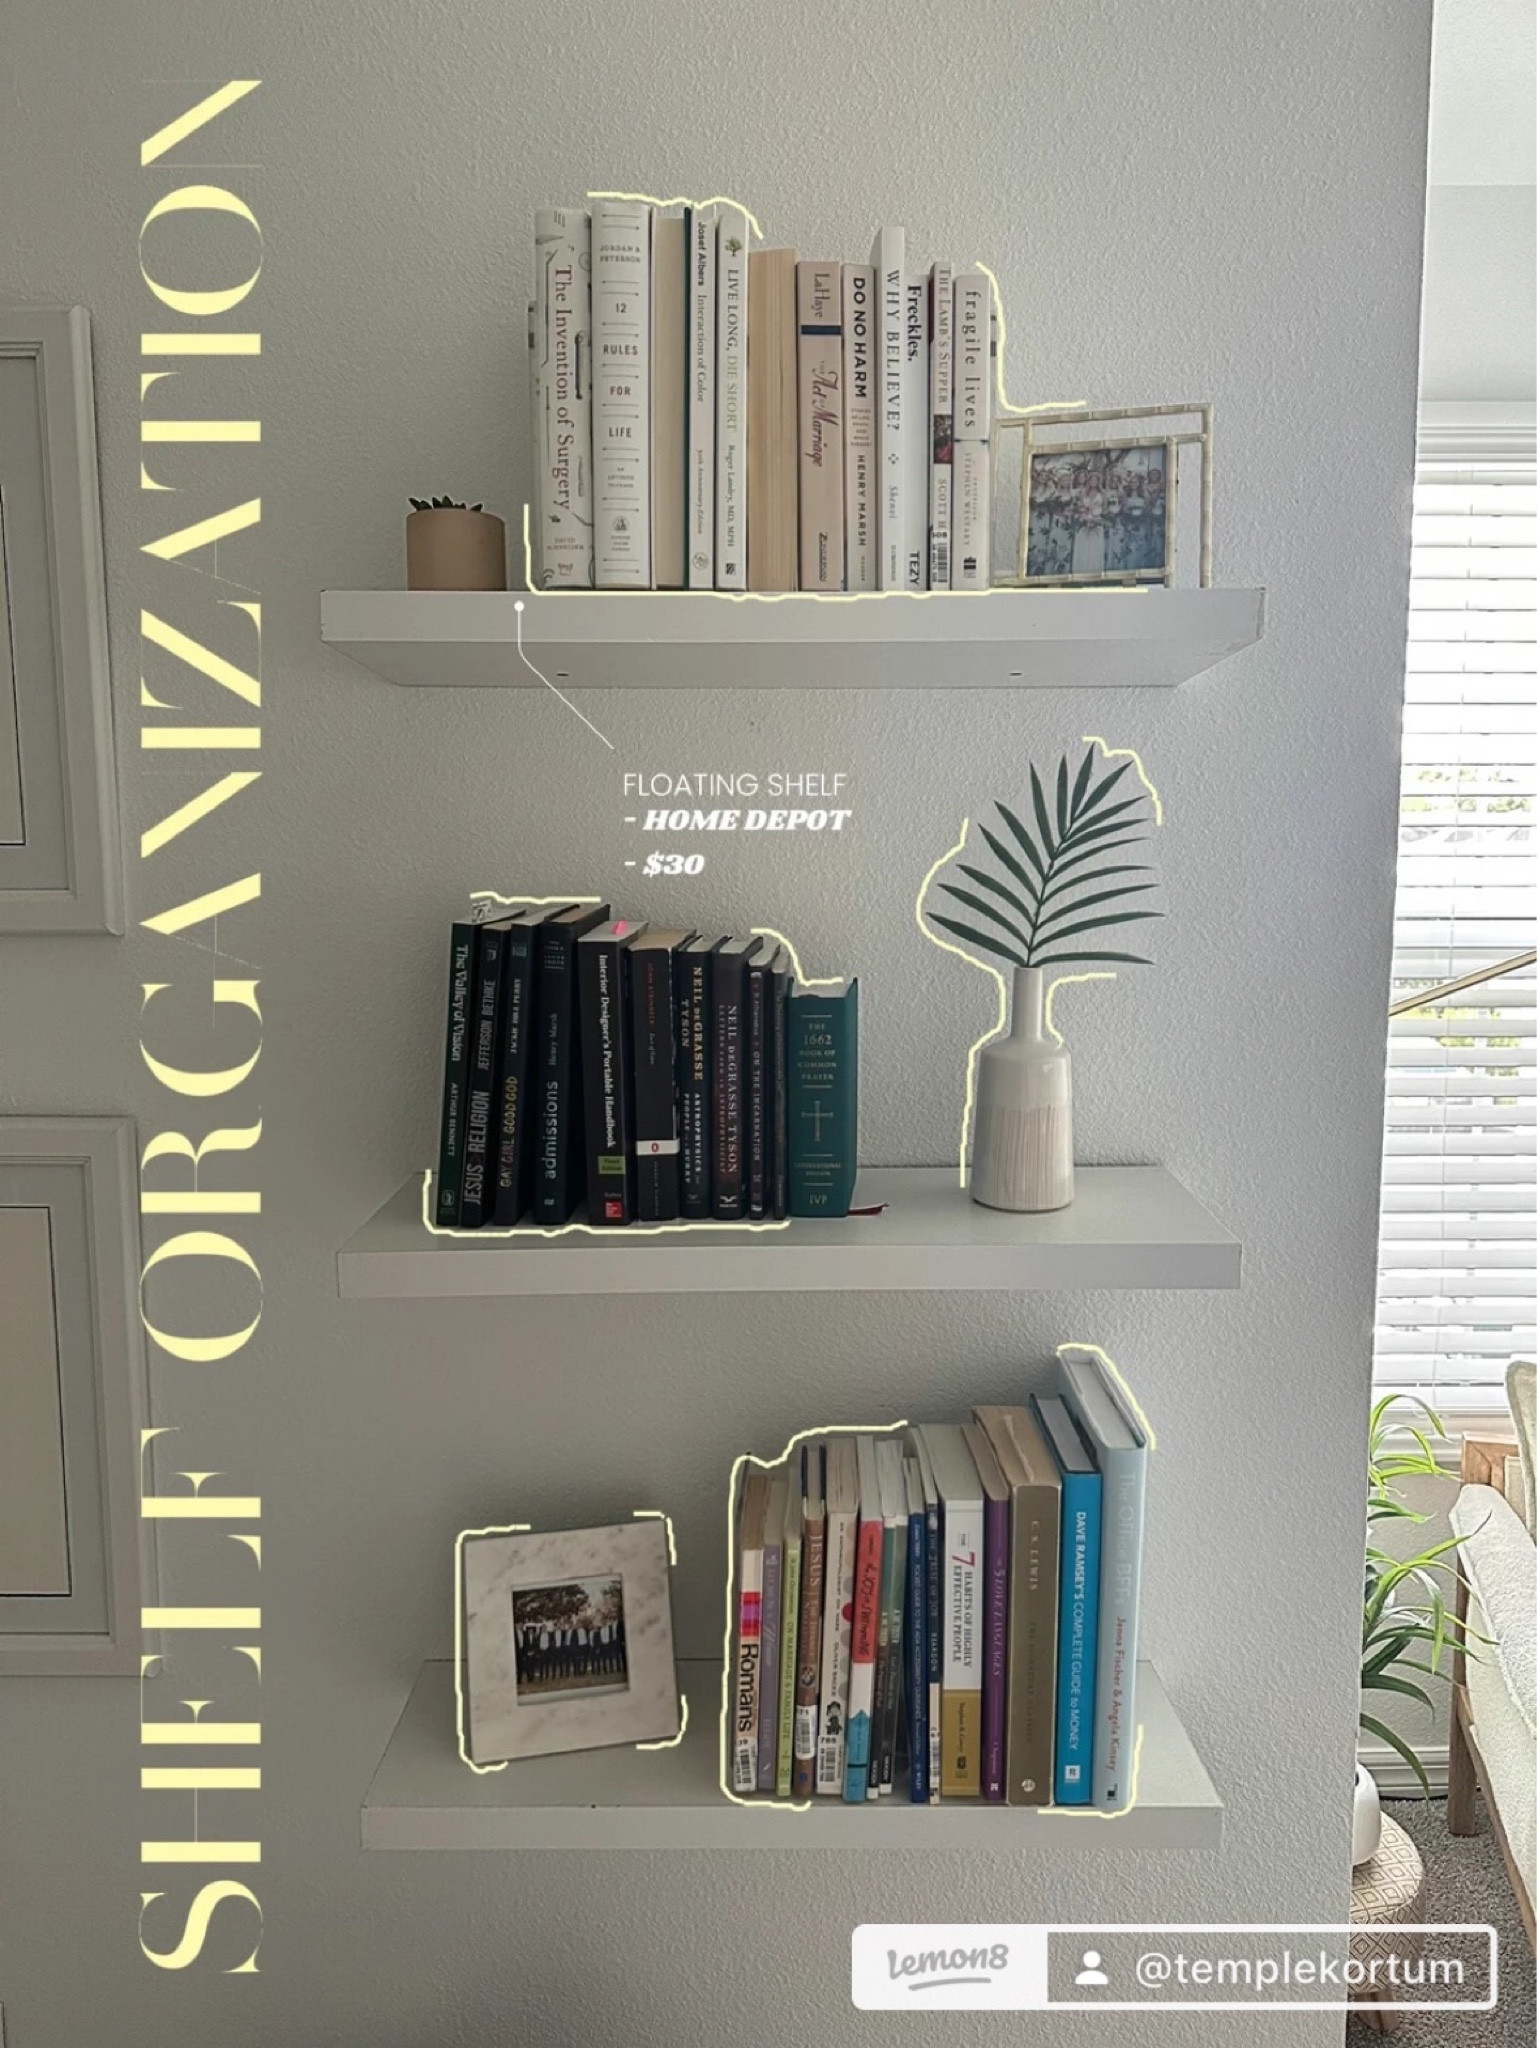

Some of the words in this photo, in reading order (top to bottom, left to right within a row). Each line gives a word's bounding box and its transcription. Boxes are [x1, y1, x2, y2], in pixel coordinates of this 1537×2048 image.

[697, 221, 707, 251] Josef
[555, 264, 573, 302] The
[697, 252, 707, 287] Albers
[726, 268, 739, 301] LIVE
[938, 268, 951, 294] THE
[615, 303, 627, 314] 12
[811, 273, 831, 318] LaHaye
[853, 277, 866, 304] DO
[887, 269, 900, 321] WHY
[697, 294, 708, 355] Interaction
[725, 304, 739, 351] LONG,
[853, 310, 867, 336] NO
[907, 285, 923, 362] Freckles.
[938, 299, 951, 347] LAMB'S
[961, 290, 982, 365] fragile
[555, 308, 574, 401] Invention
[603, 345, 639, 356] RULES
[726, 355, 738, 378] DIE
[696, 371, 707, 403] Color
[854, 342, 868, 398] HARM
[887, 331, 901, 431] BELIEVE?
[938, 352, 950, 403] SUPPER
[610, 386, 631, 396] FOR
[726, 382, 738, 432] SHORT
[964, 376, 981, 428] lives
[556, 406, 575, 429] of
[608, 427, 632, 438] LIFE
[804, 403, 839, 468] Marriage
[552, 434, 575, 511] Surgery
[857, 454, 867, 498] HENRY
[937, 478, 948, 516] SCOTT
[858, 502, 867, 546] MARSH
[908, 550, 921, 585] TEZY
[455, 944, 470, 969] The
[598, 954, 609, 994] Interior
[452, 970, 468, 1010] Valley
[481, 979, 497, 1016] BETHKE
[692, 967, 703, 1003] NEIL
[453, 1010, 466, 1021] of
[599, 996, 611, 1049] Designer's
[680, 998, 690, 1048] TYSON
[727, 1005, 738, 1040] NEIL
[450, 1022, 464, 1062] Vision
[477, 1019, 492, 1072] JEFFERSON
[752, 1051, 760, 1066] ON
[803, 1033, 833, 1046] 1662
[823, 1049, 836, 1057] OF
[603, 1050, 615, 1094] Portable
[796, 1061, 838, 1069] COMMON
[505, 1075, 518, 1101] GOD
[467, 1091, 490, 1153] RELIGION
[503, 1103, 517, 1134] GOOD
[541, 1080, 559, 1179] admissions
[604, 1096, 617, 1149] Handbook
[693, 1092, 702, 1173] ASTROPHYSICS
[501, 1138, 514, 1164] GIRL
[727, 1125, 738, 1173] TYSON
[463, 1163, 484, 1206] JESUS
[500, 1165, 512, 1188] GAY
[809, 1193, 828, 1205] IVP
[1120, 1472, 1136, 1500] The
[1075, 1511, 1087, 1542] DAVE
[1118, 1504, 1134, 1560] Office
[809, 1535, 823, 1587] JESUS
[950, 1551, 977, 1567] 7
[993, 1568, 1006, 1577] 5
[1029, 1549, 1039, 1592] LEWIS
[1074, 1544, 1086, 1600] RAMSEY'S
[952, 1565, 963, 1622] EFFECTIVE
[963, 1571, 974, 1611] HABITS
[1115, 1563, 1132, 1604] BFFs
[963, 1612, 973, 1625] OF
[1071, 1601, 1084, 1660] COMPLETE
[1115, 1616, 1127, 1647] Jenna
[784, 1637, 794, 1679] MARRIAGE
[952, 1623, 962, 1663] PEOPLE
[963, 1627, 973, 1668] HIGHLY
[1070, 1661, 1082, 1695] GUIDE
[1113, 1649, 1125, 1686] Fischer
[738, 1643, 760, 1733] Romans
[784, 1690, 793, 1720] FAMILY
[1070, 1696, 1080, 1708] to
[1113, 1689, 1123, 1697] &
[783, 1722, 792, 1739] LIFE
[1069, 1709, 1080, 1751] MONEY
[1108, 1699, 1123, 1736] Angela
[1105, 1737, 1121, 1773] Kinsey
